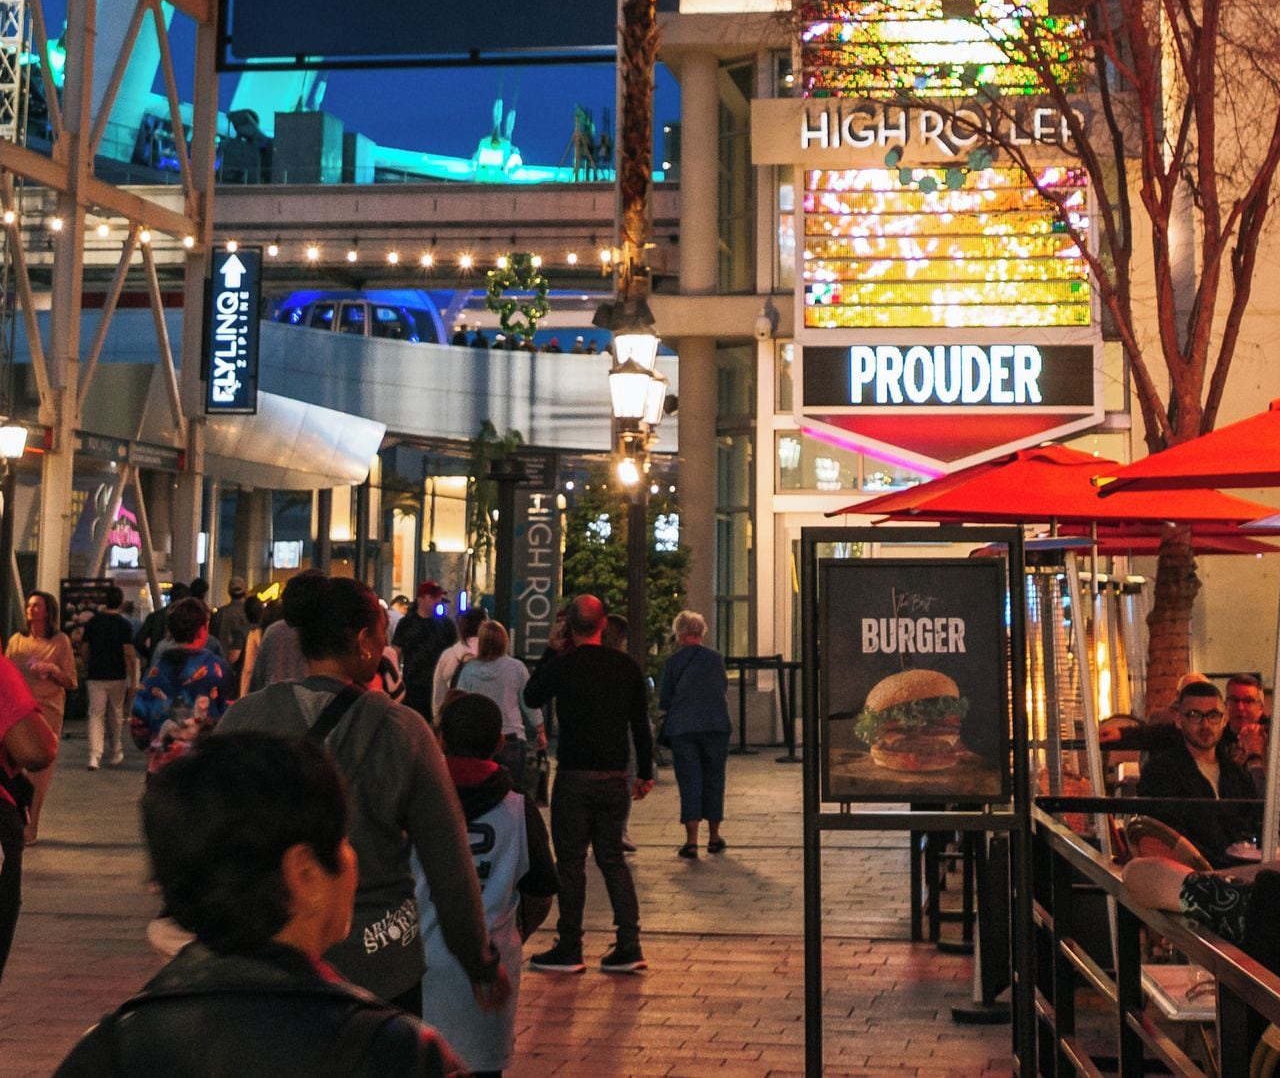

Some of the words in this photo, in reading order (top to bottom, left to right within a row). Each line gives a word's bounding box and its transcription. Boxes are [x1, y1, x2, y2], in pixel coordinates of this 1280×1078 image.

[800, 110, 907, 149] HIGH
[212, 291, 240, 402] FLYLINQ
[236, 291, 249, 368] ZIPLINE
[849, 345, 1043, 404] PROUDER
[527, 493, 553, 567] HIGH
[862, 616, 966, 654] BURGER
